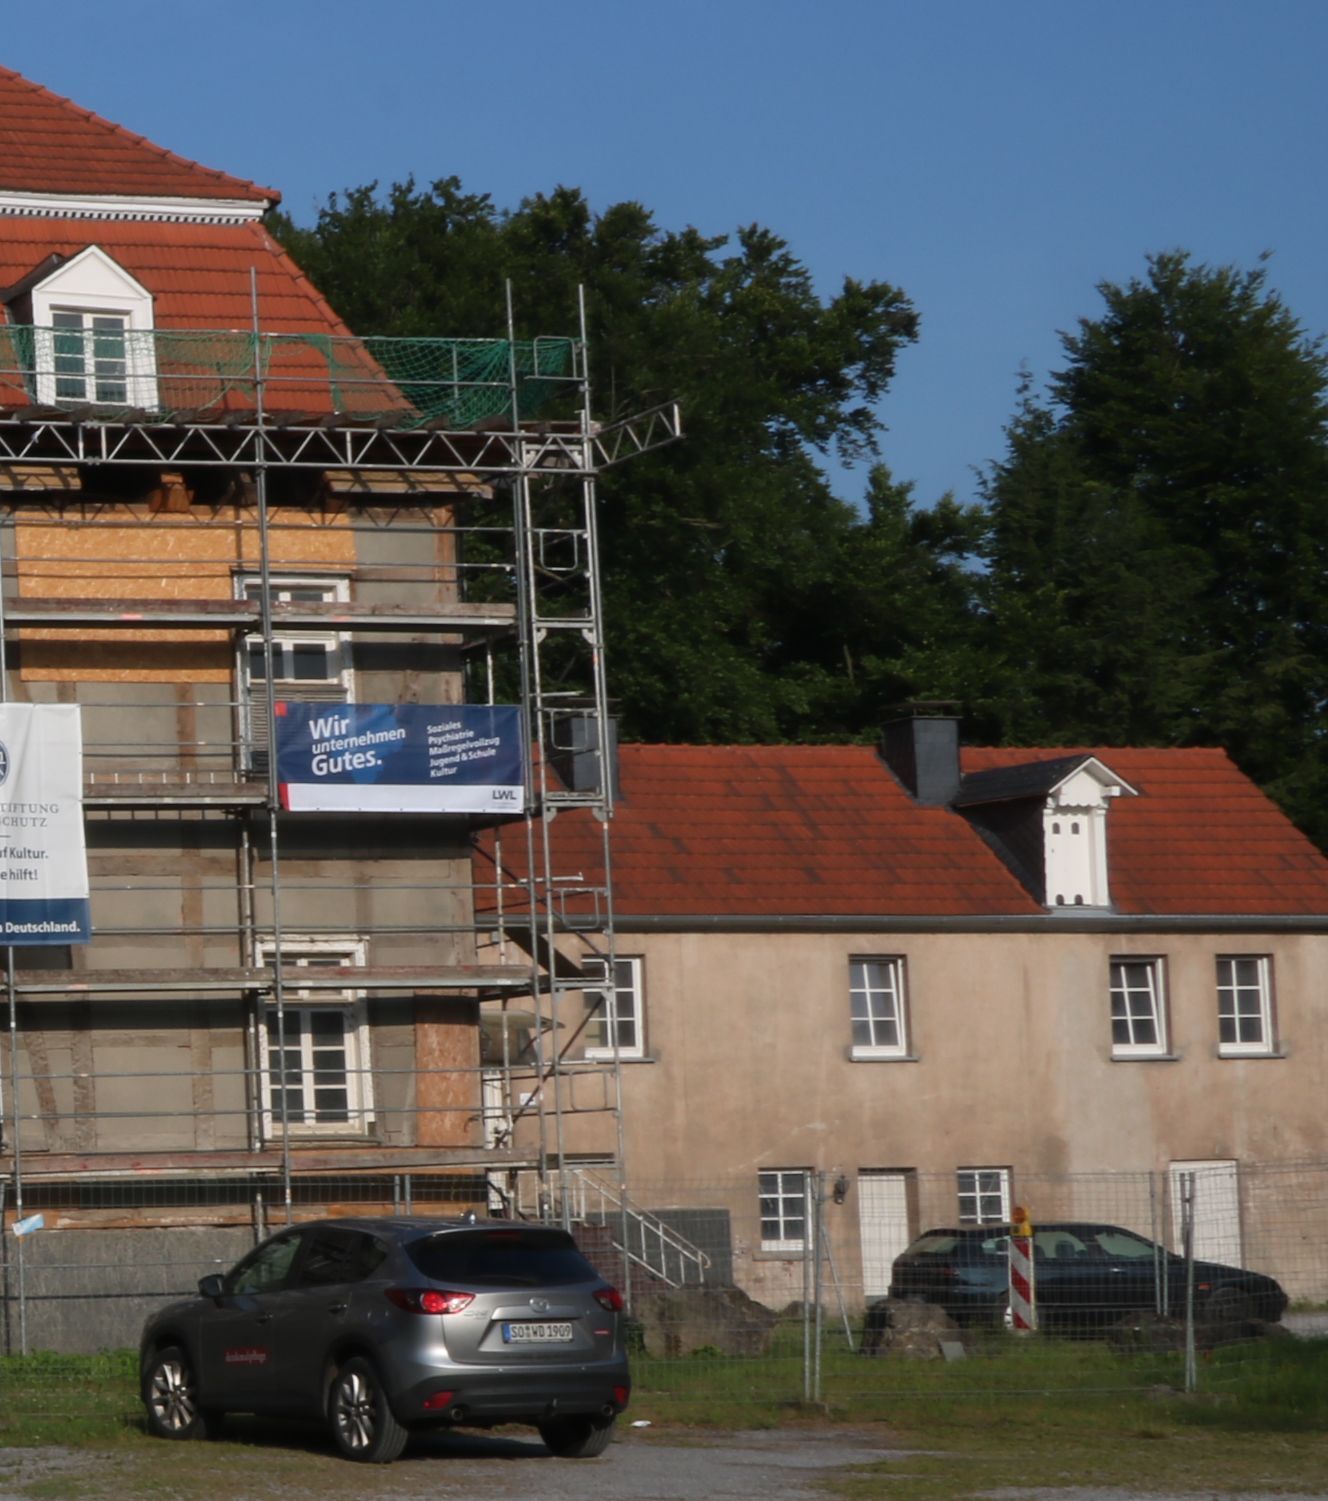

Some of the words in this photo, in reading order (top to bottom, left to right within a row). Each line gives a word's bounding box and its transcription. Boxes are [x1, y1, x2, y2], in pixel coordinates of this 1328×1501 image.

[309, 716, 349, 740] Wir
[427, 722, 461, 734] Soziales
[312, 728, 406, 754] unternehmen
[428, 730, 474, 744] Psychiatrie
[429, 736, 500, 756] Maßregelvollzug
[312, 751, 382, 776] Gutes.
[430, 754, 460, 767] Jugend
[460, 752, 467, 761] &
[468, 747, 496, 760] Schule
[430, 766, 458, 778] Kultur
[492, 790, 516, 800] LWL
[9, 847, 49, 859] Kultur.
[9, 868, 38, 880] hilft!
[6, 921, 80, 933] Deutschland.
[511, 1326, 524, 1338] SO
[548, 1325, 570, 1337] 1909
